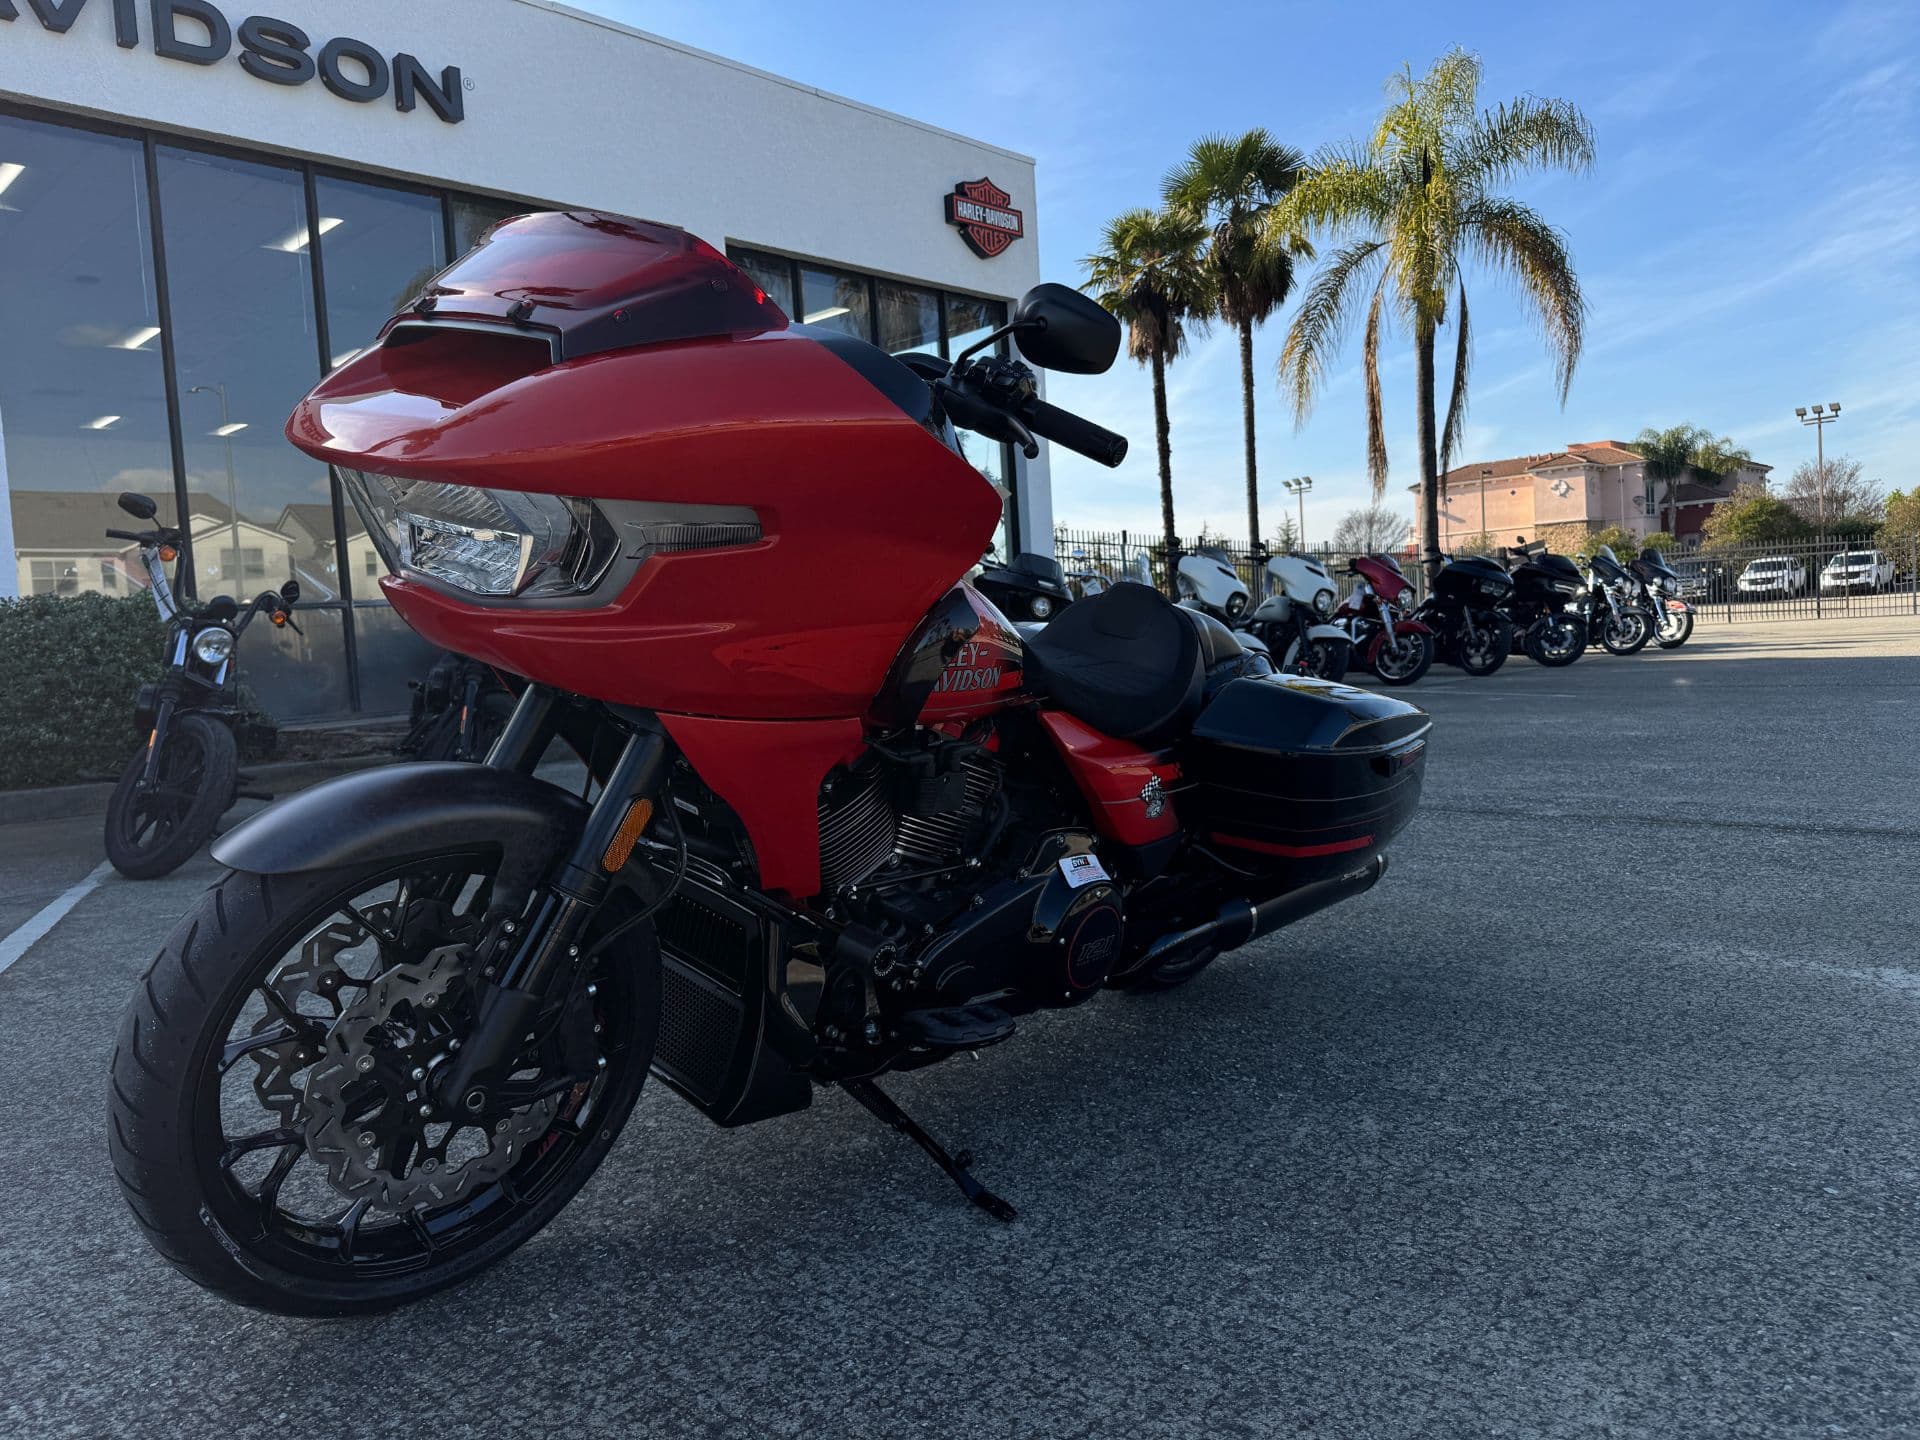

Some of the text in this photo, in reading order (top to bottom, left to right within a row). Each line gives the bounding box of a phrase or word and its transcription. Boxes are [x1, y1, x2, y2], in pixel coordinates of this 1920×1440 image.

[0, 0, 465, 124] VIDSON
[971, 186, 1004, 208] MOTOR
[957, 200, 1019, 231] HARLEY-DAVIDSON
[973, 226, 1005, 251] CYCLES
